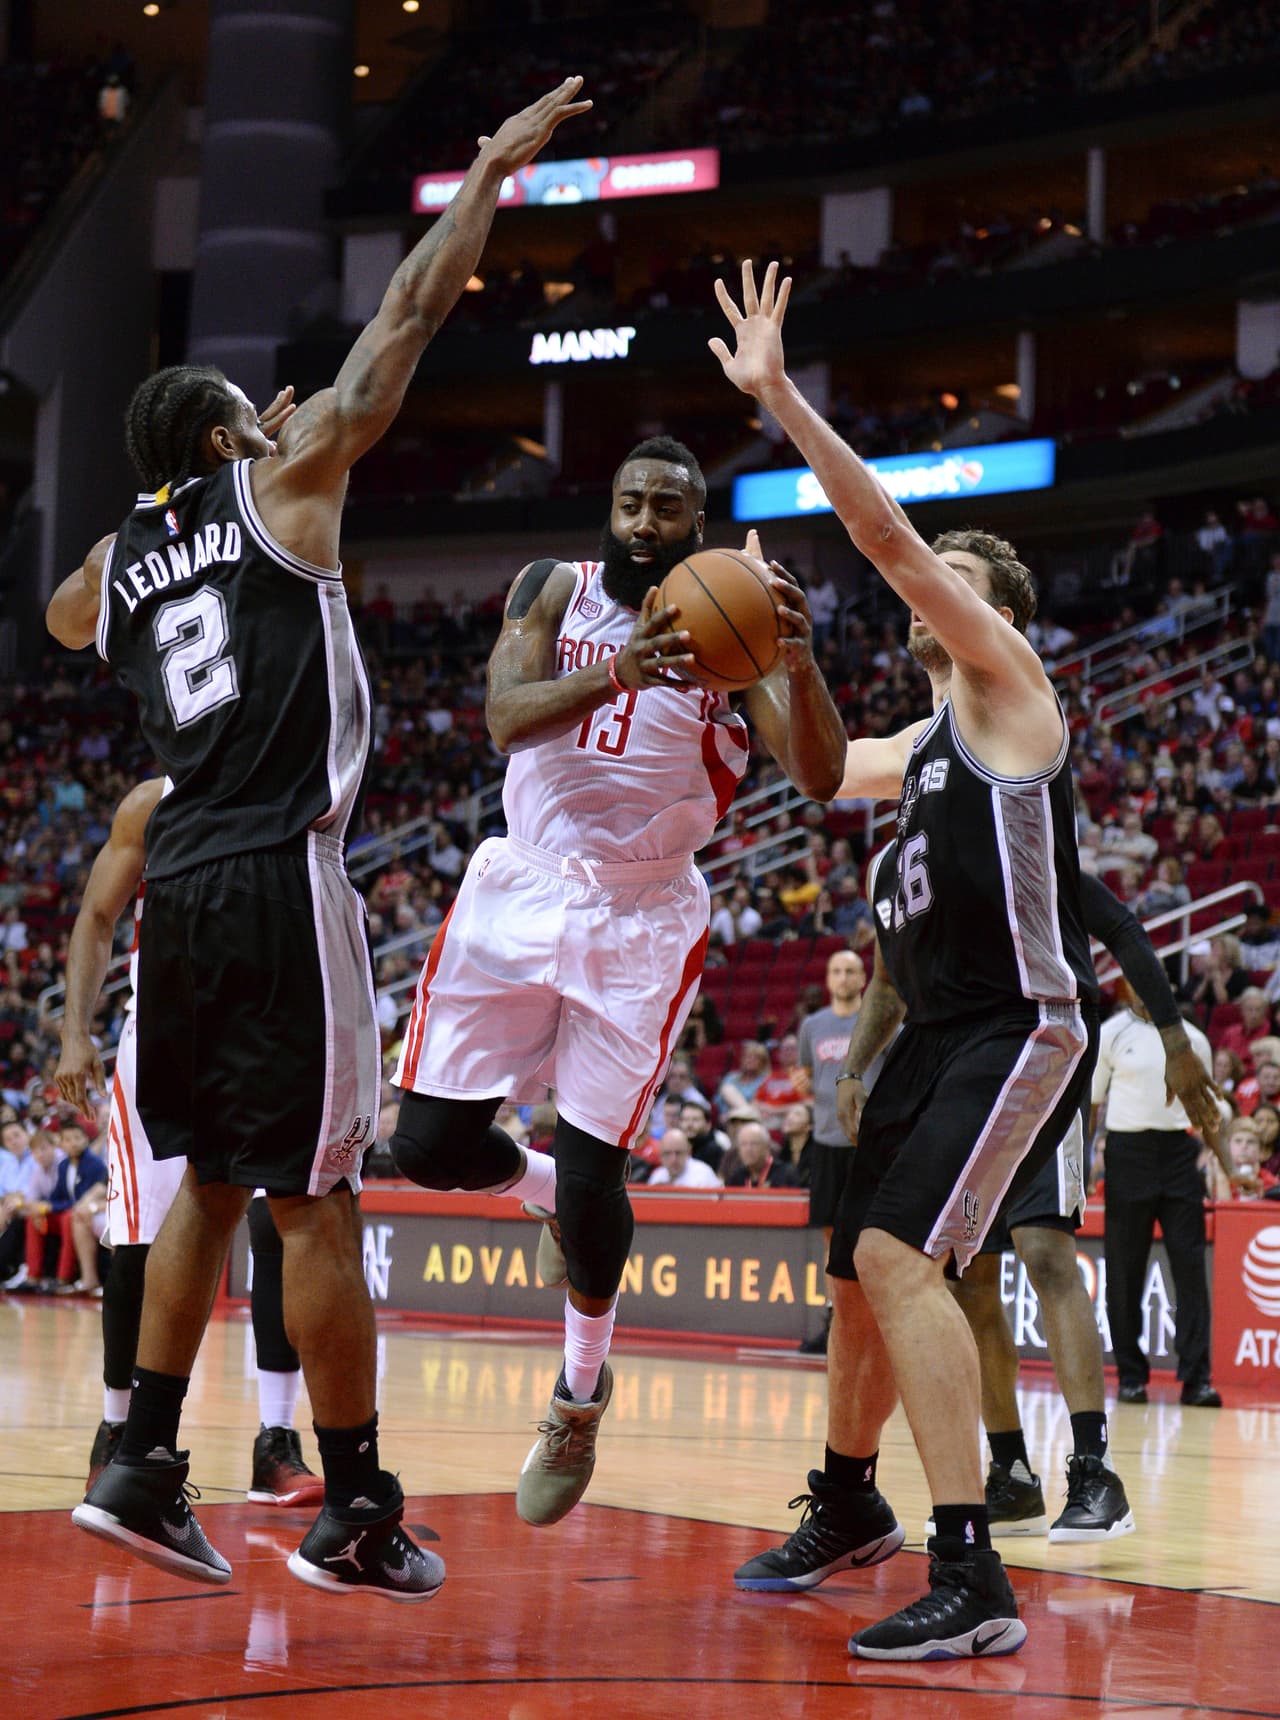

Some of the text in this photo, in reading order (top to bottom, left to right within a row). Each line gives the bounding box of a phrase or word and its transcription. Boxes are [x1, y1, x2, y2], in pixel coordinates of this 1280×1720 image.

[113, 521, 241, 614] LEONARD
[583, 601, 598, 614] 50
[152, 584, 240, 731] 2
[576, 690, 640, 758] 13
[423, 1243, 677, 1297] ADVANG
